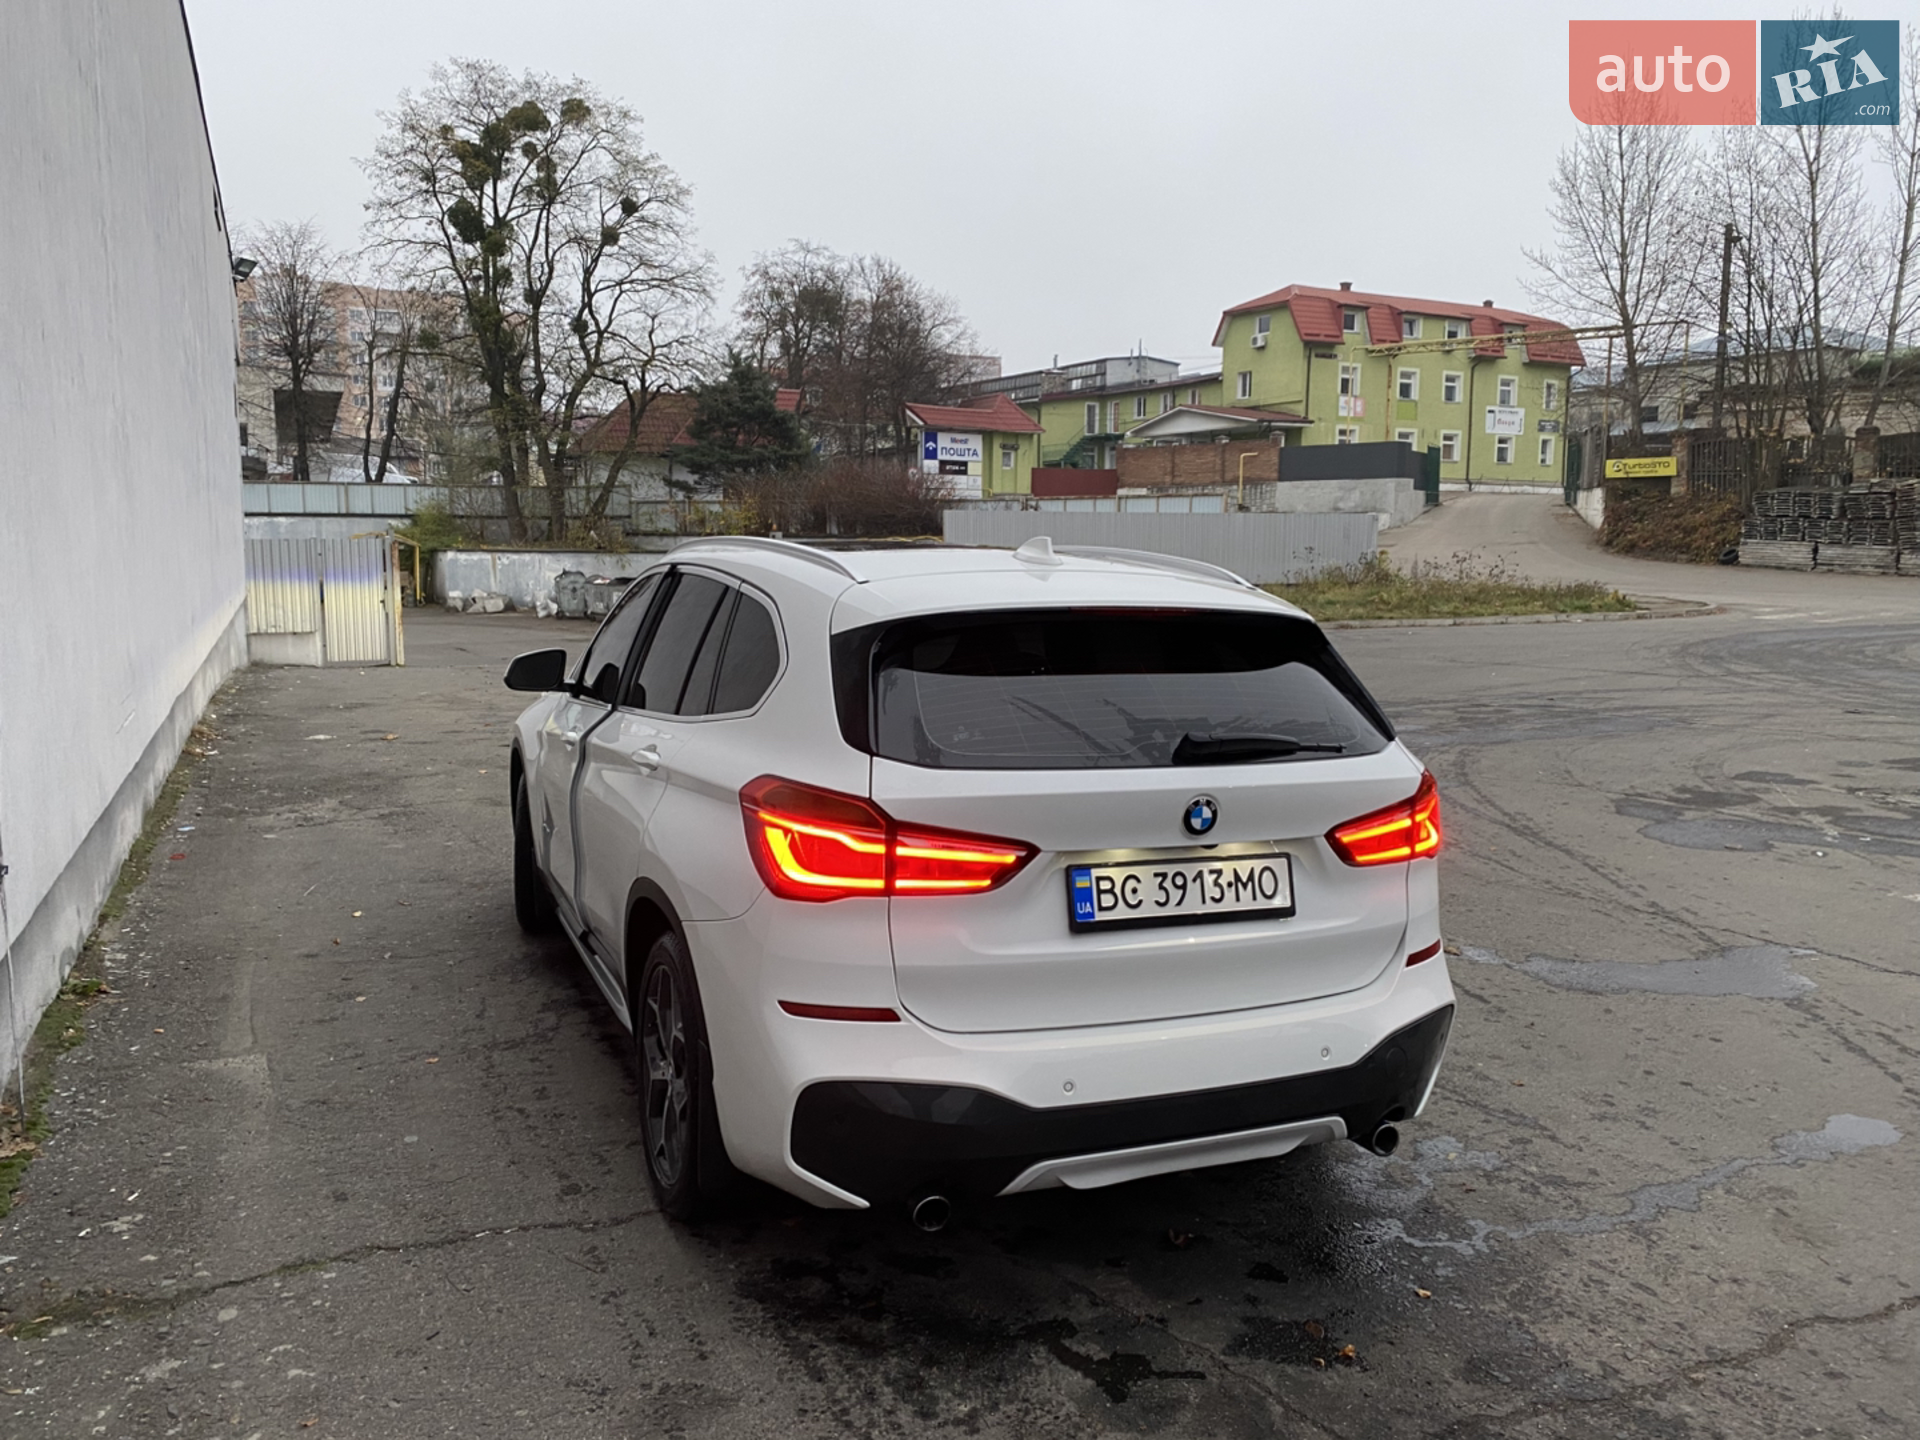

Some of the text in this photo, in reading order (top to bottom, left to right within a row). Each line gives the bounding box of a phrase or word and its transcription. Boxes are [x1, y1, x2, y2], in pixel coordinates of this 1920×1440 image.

[940, 446, 979, 458] ПОШТА
[1095, 866, 1279, 912] BC 3913 MO
[1077, 901, 1093, 914] UA
